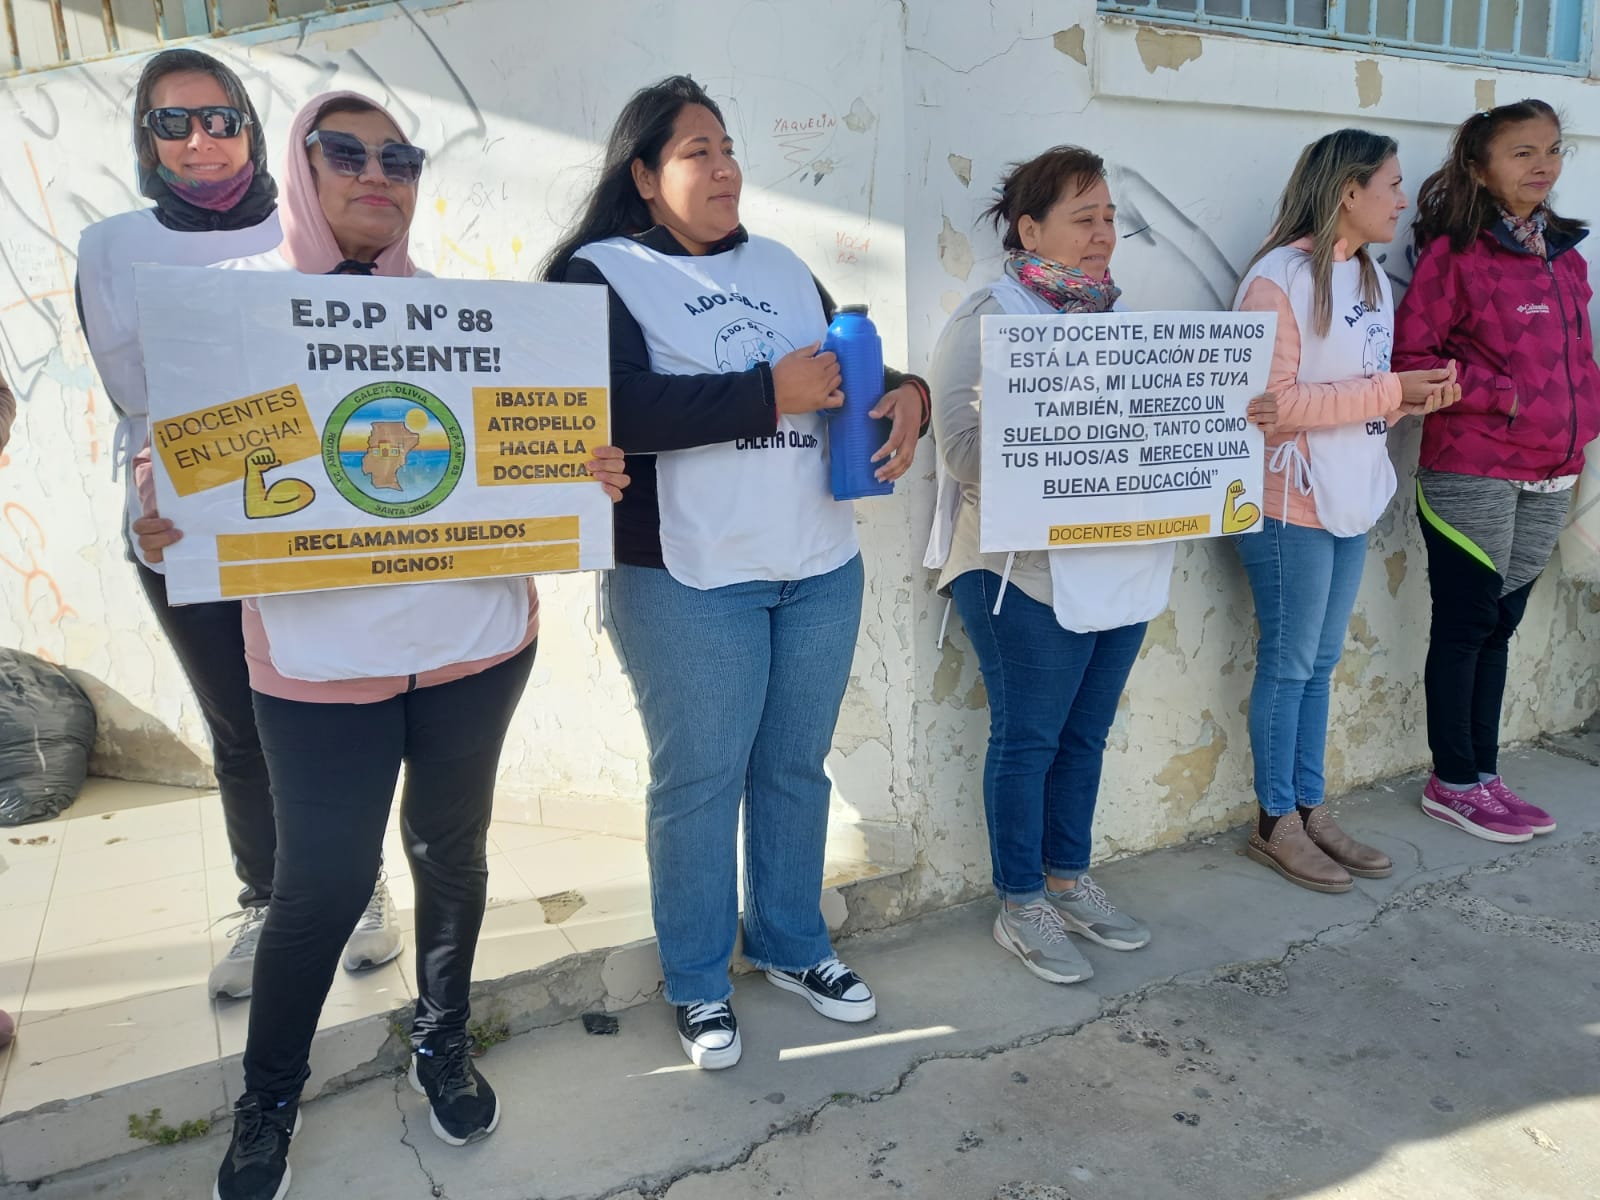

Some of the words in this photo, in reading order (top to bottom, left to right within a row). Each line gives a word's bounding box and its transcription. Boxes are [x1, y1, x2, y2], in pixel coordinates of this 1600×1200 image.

[291, 298, 387, 329] E.P.P
[457, 308, 493, 332] 88
[999, 326, 1048, 343] “SOY
[1053, 325, 1148, 343] DOCENTE,
[1153, 324, 1175, 340] EN
[1179, 324, 1206, 340] MIS
[1209, 323, 1265, 340] MANOS
[306, 342, 501, 373] ¡PRESENTE!
[1010, 347, 1060, 368] ESTÁ
[1066, 351, 1090, 366] LA
[1096, 344, 1195, 366] EDUCACIÓN
[1198, 348, 1220, 364] DE
[1223, 347, 1253, 363] TUS
[353, 385, 393, 404] CALETA
[394, 386, 428, 403] OLIVIA
[1008, 375, 1101, 394] HIJOS/AS,
[1106, 374, 1126, 391] MI
[1131, 373, 1182, 390] LUCHA
[1186, 372, 1205, 387] ES
[1210, 371, 1249, 387] TUYA
[495, 391, 559, 408] ¡BASTA
[564, 391, 588, 406] DE
[1034, 395, 1124, 418] TAMBIÉN,
[1129, 396, 1202, 415] MEREZCO
[1205, 394, 1225, 410] UN
[157, 390, 298, 449] ¡DOCENTES
[487, 415, 596, 432] ATROPELLO
[1003, 425, 1081, 444] SUELDO
[1087, 422, 1148, 441] DIGNO,
[1154, 420, 1201, 437] TANTO
[1205, 417, 1247, 434] COMO
[174, 444, 211, 470] EN
[214, 417, 302, 458] LUCHA!
[327, 432, 337, 467] ROTARY
[499, 440, 559, 456] HACIA
[563, 439, 586, 455] LA
[1001, 452, 1039, 468] TUS
[1045, 448, 1129, 467] HIJOS/AS
[1140, 442, 1213, 463] MERECEN
[1218, 440, 1250, 457] UNA
[1043, 477, 1110, 496] BUENA
[1116, 466, 1218, 492] EDUCACIÓN”
[375, 504, 406, 516] SANTA
[408, 500, 432, 514] CRUZ
[288, 528, 439, 556] ¡RECLAMAMOS
[444, 522, 526, 542] SUELDOS
[1049, 524, 1132, 541] DOCENTES
[1137, 523, 1156, 537] EN
[1158, 519, 1199, 535] LUCHA
[371, 555, 454, 575] DIGNOS!
